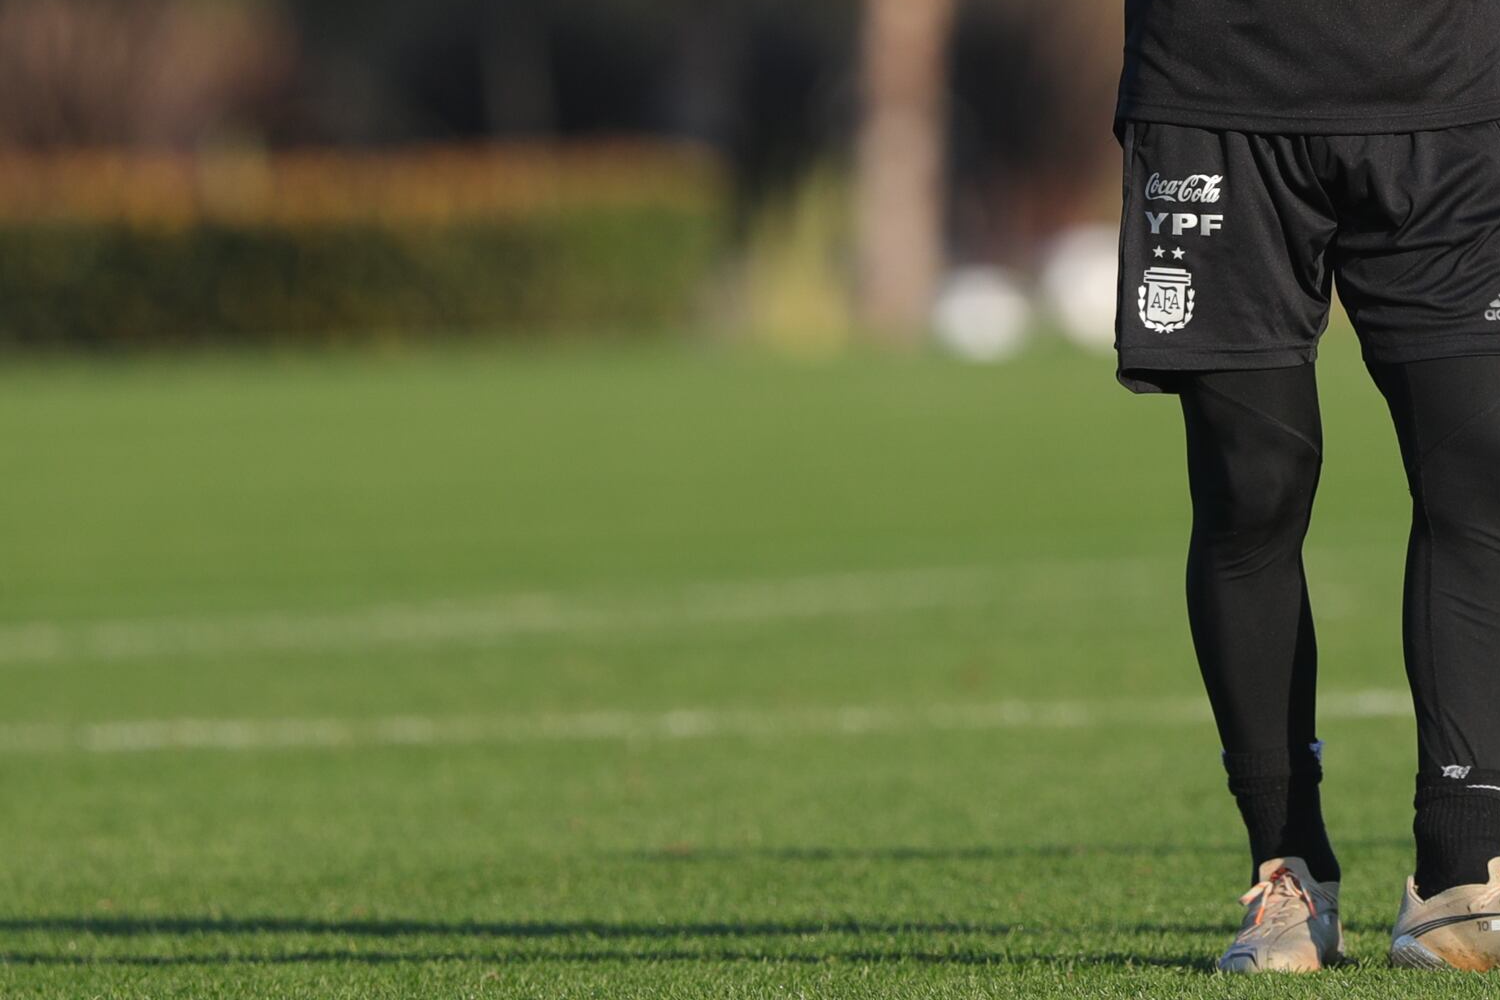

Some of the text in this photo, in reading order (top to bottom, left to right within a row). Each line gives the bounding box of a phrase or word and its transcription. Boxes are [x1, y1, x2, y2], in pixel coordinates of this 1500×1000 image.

[1145, 172, 1224, 204] Coca-Cola
[1144, 211, 1224, 237] YPF
[1150, 285, 1181, 315] AFA
[1476, 920, 1489, 932] 10
